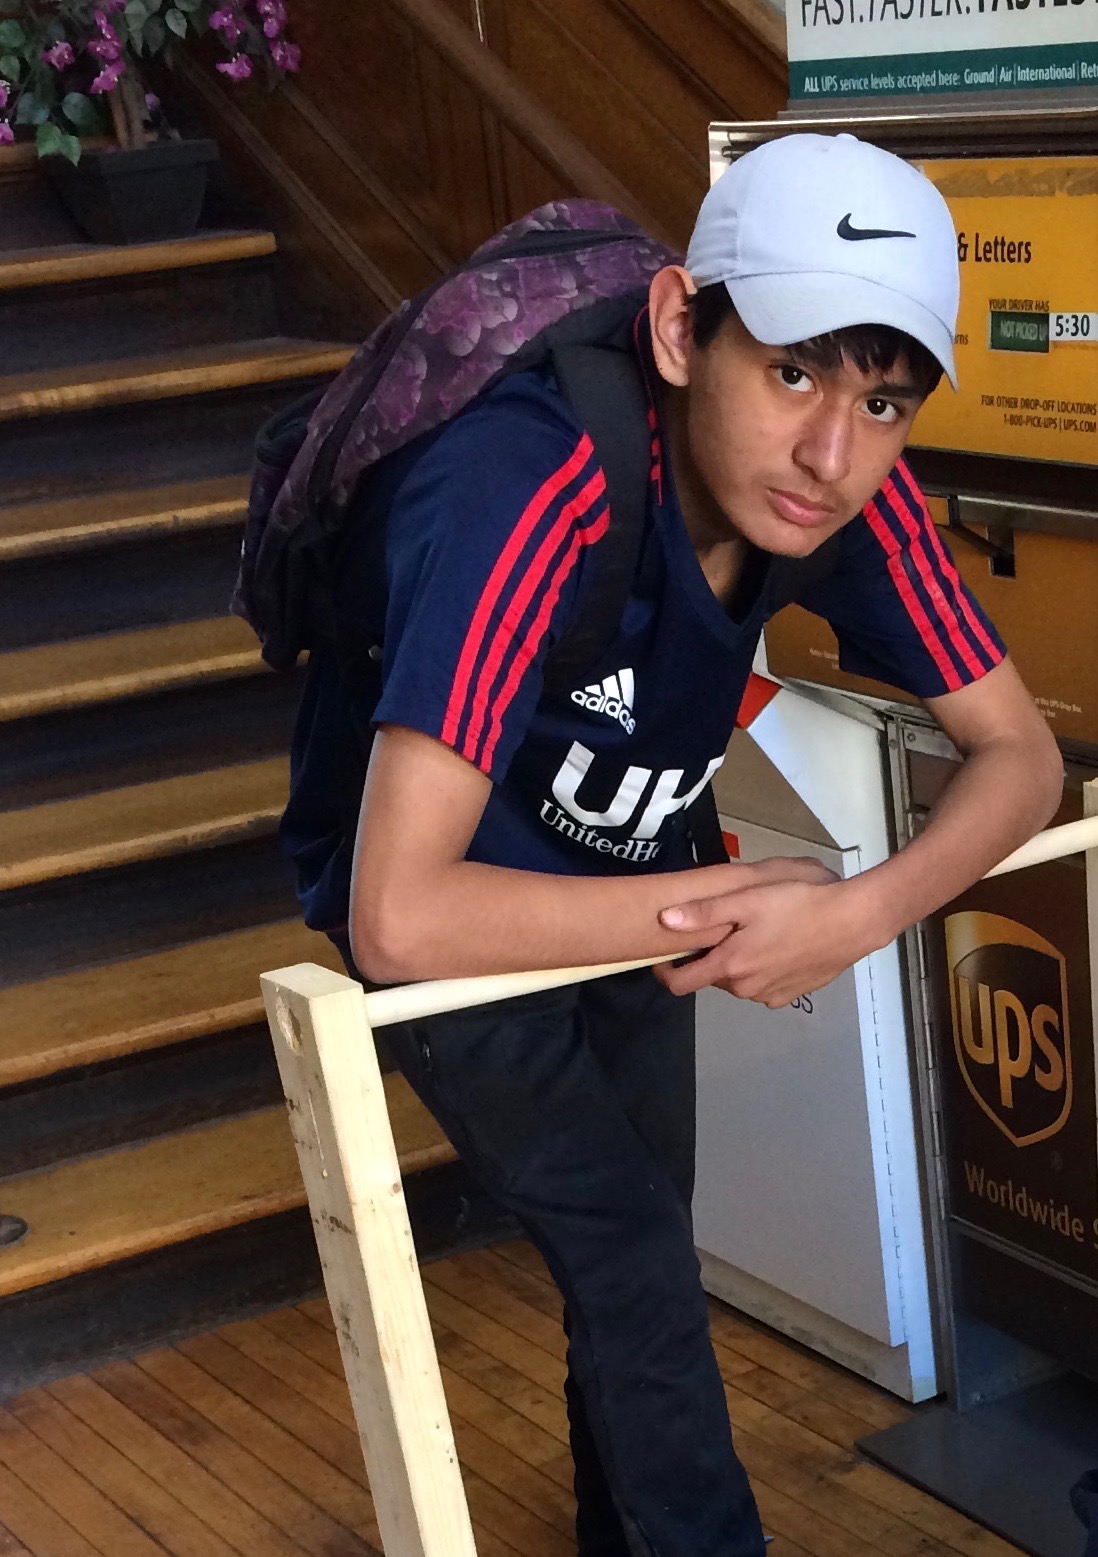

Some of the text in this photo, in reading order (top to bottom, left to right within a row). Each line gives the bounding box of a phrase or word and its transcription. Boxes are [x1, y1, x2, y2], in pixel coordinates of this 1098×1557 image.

[804, 76, 819, 93] ALL
[821, 75, 838, 92] UPS
[839, 76, 869, 91] service
[870, 73, 894, 90] levels
[897, 70, 936, 91] accepted
[963, 68, 995, 85] Ground
[999, 66, 1014, 82] Air
[1017, 63, 1076, 82] International
[974, 232, 1032, 263] Letters
[1008, 299, 1034, 311] DRIVER
[1055, 314, 1090, 337] 5:30
[981, 394, 994, 406] FOR
[996, 395, 1018, 409] OTHER
[1057, 402, 1097, 416] LOCATIONS
[571, 690, 636, 735] adidas
[539, 799, 662, 863] UnitedH
[963, 1160, 1085, 1243] Worldwide
